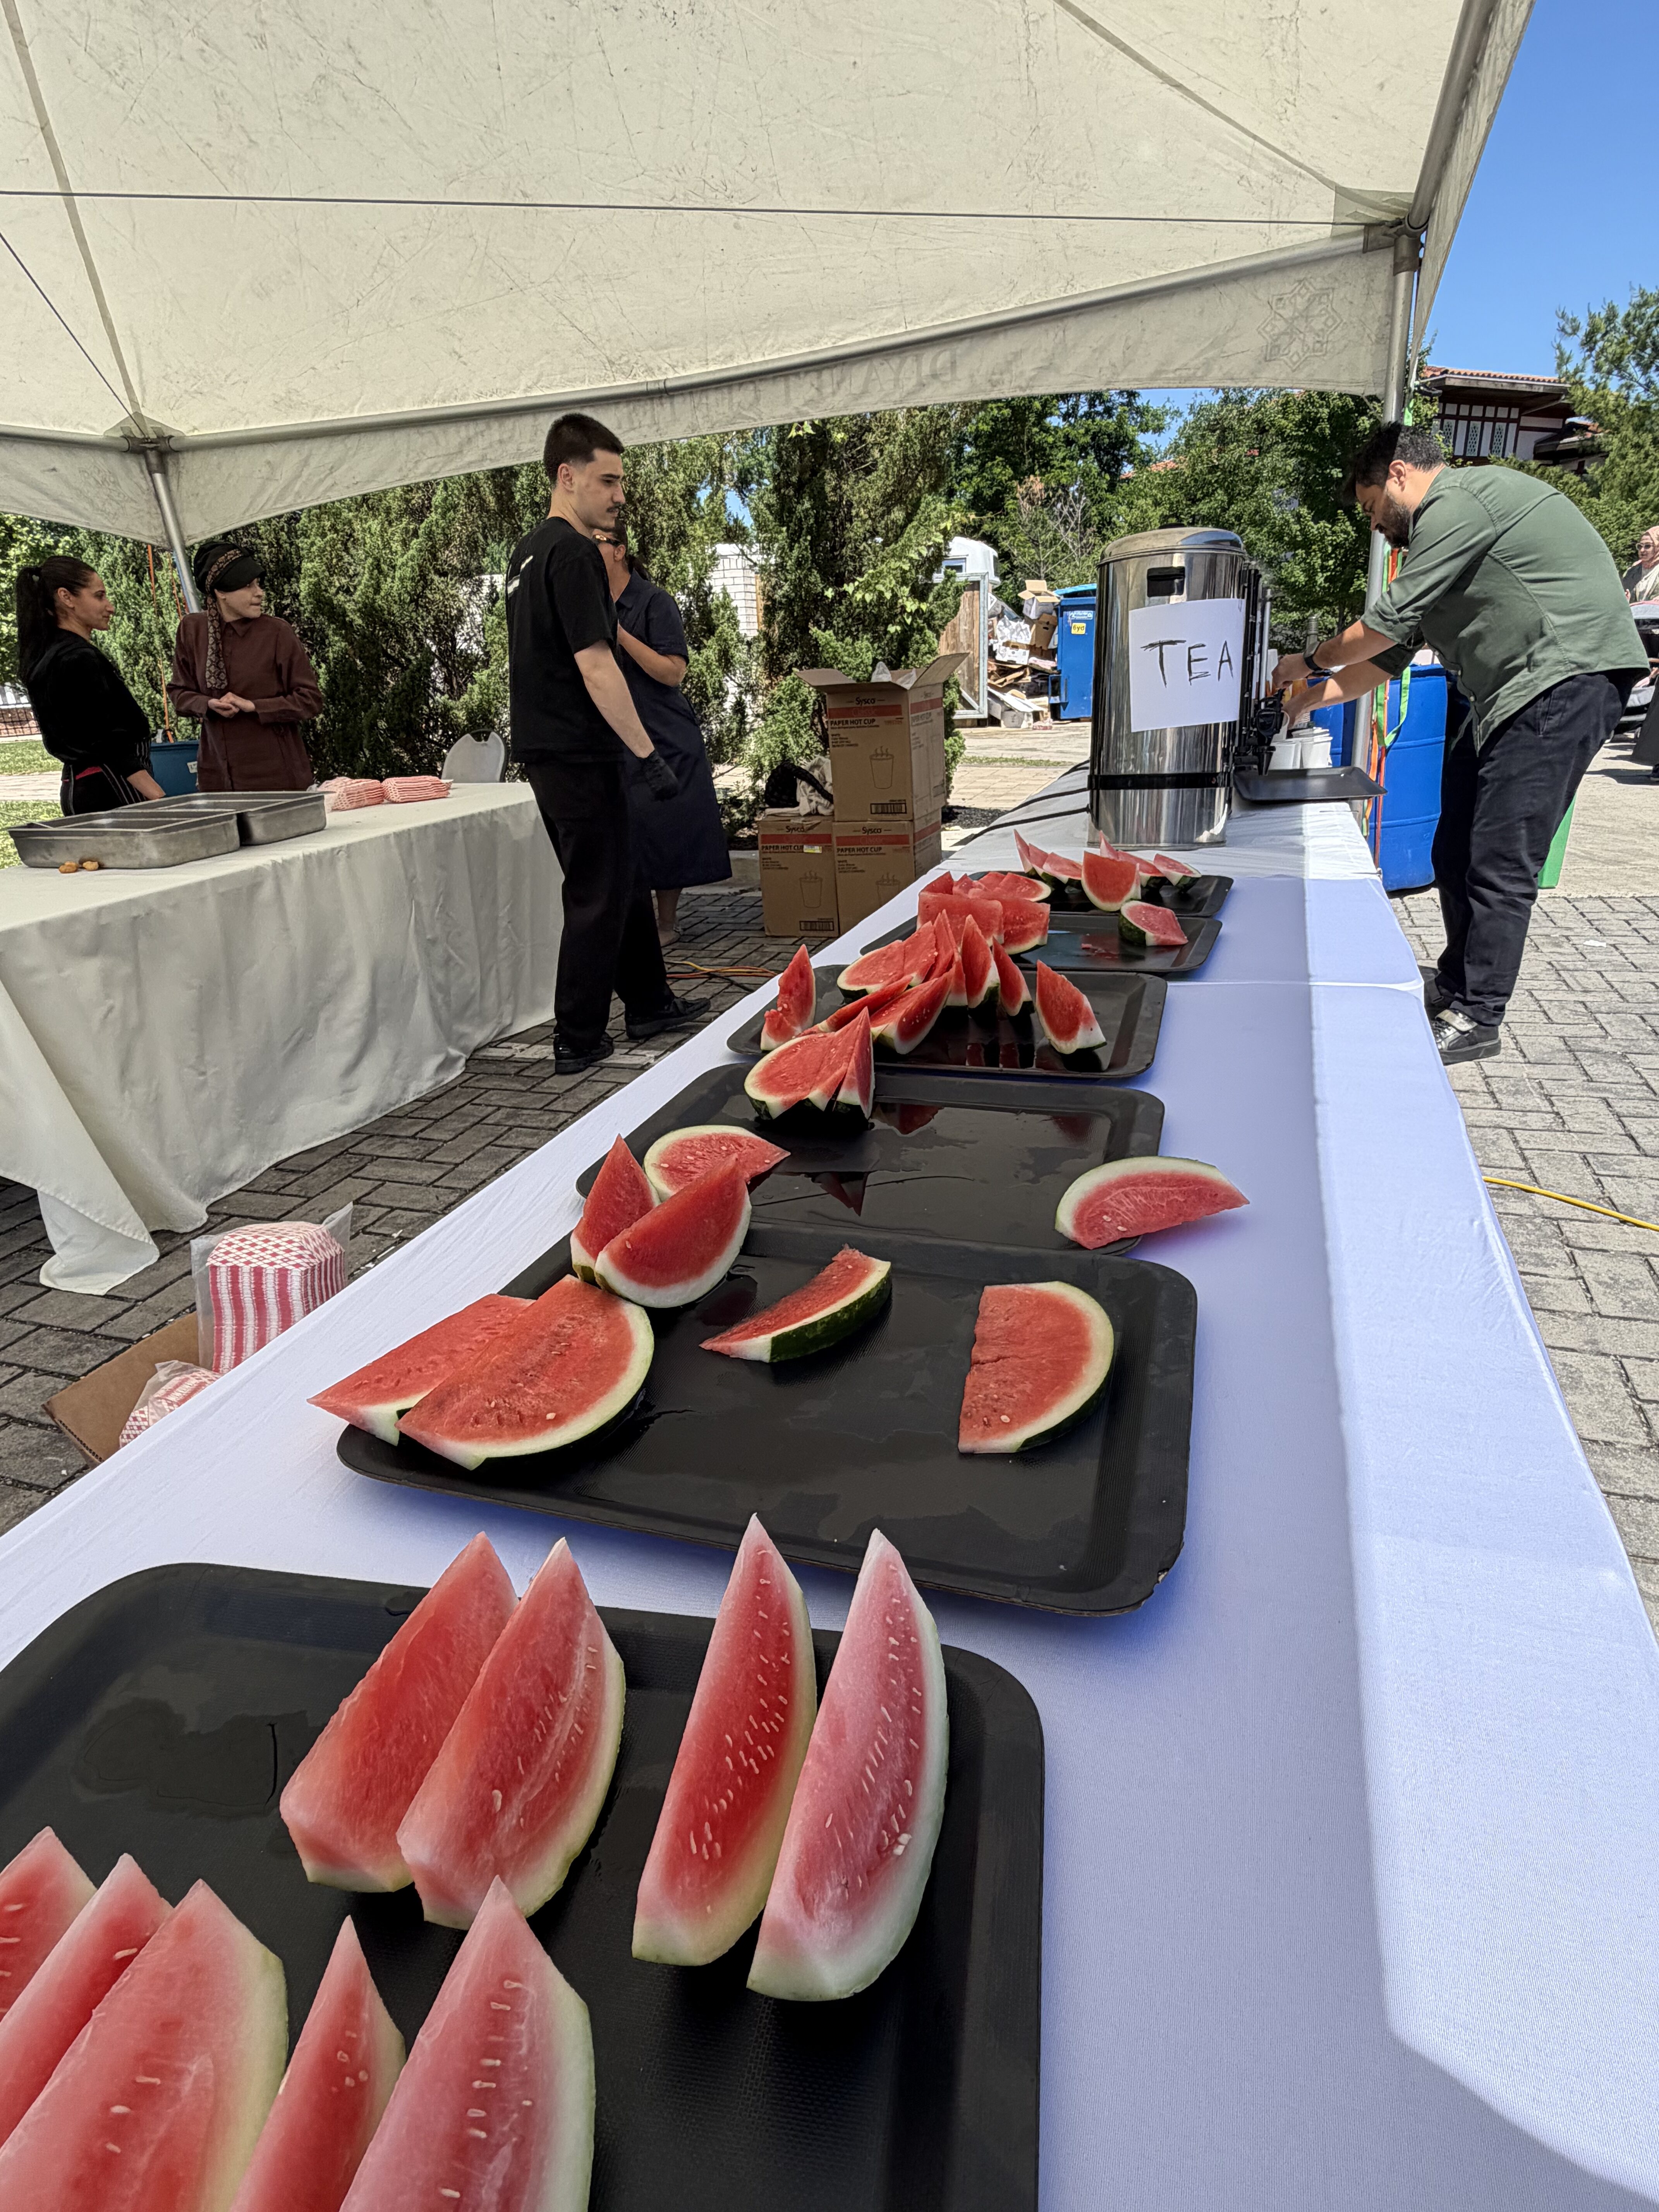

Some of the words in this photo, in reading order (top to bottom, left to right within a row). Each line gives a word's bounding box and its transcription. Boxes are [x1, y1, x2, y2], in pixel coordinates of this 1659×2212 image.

[1140, 639, 1234, 688] TEA
[855, 697, 876, 706] Sysco
[862, 826, 882, 835] Sysco
